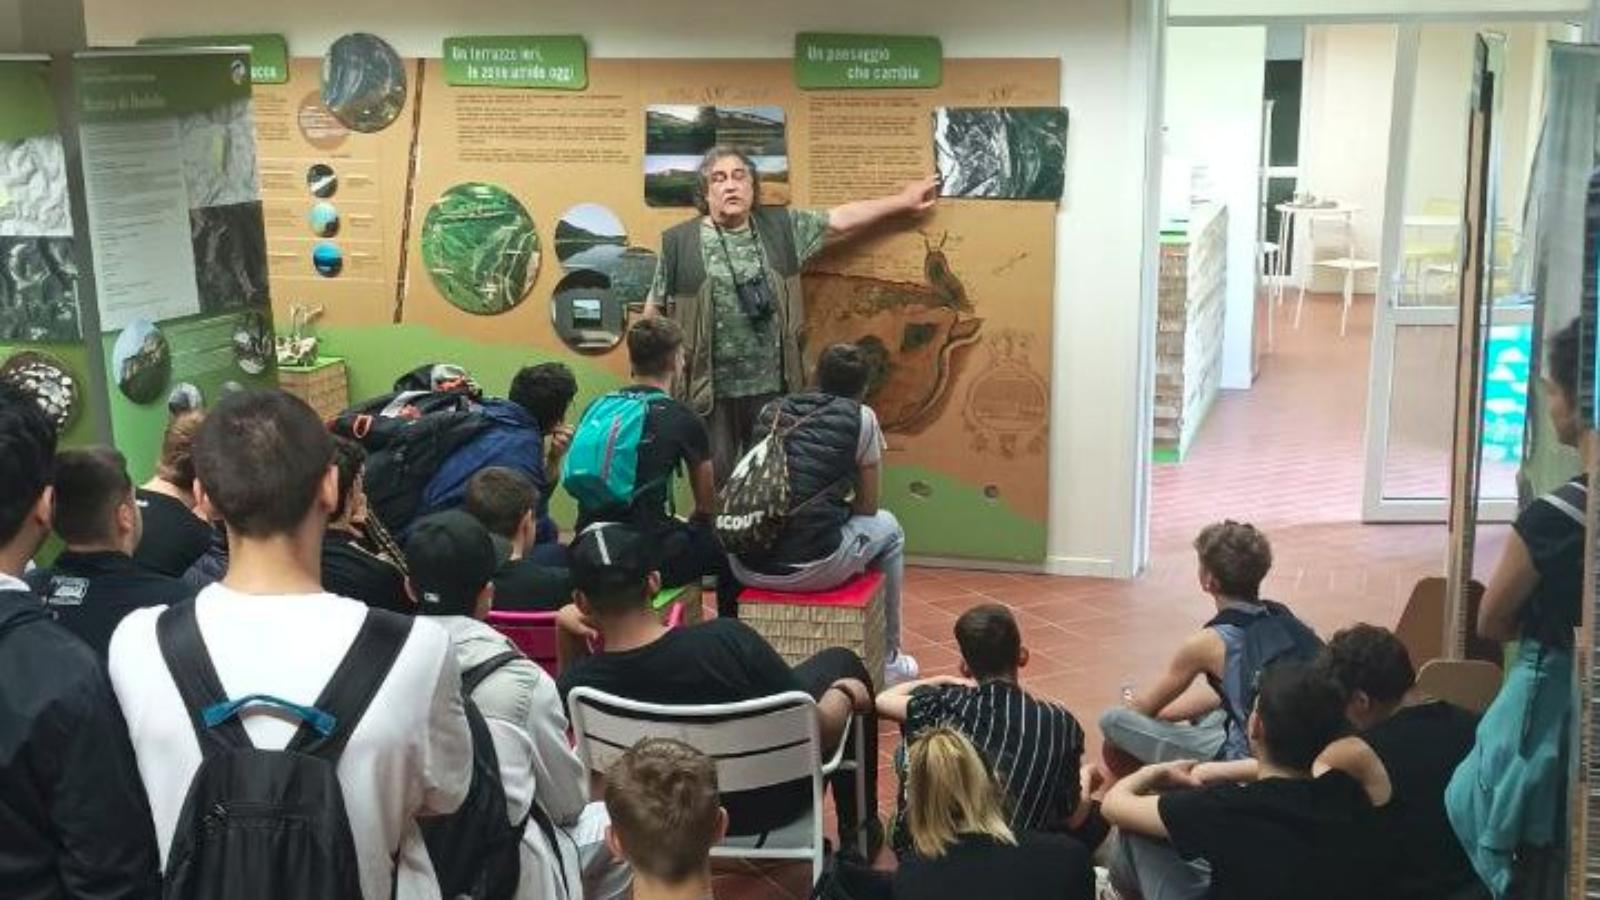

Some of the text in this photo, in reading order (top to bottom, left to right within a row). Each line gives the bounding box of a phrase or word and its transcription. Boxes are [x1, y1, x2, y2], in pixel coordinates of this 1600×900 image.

[808, 44, 890, 64] Un paesaggio
[847, 65, 920, 80] che cambia
[716, 511, 766, 530] SCOUT
